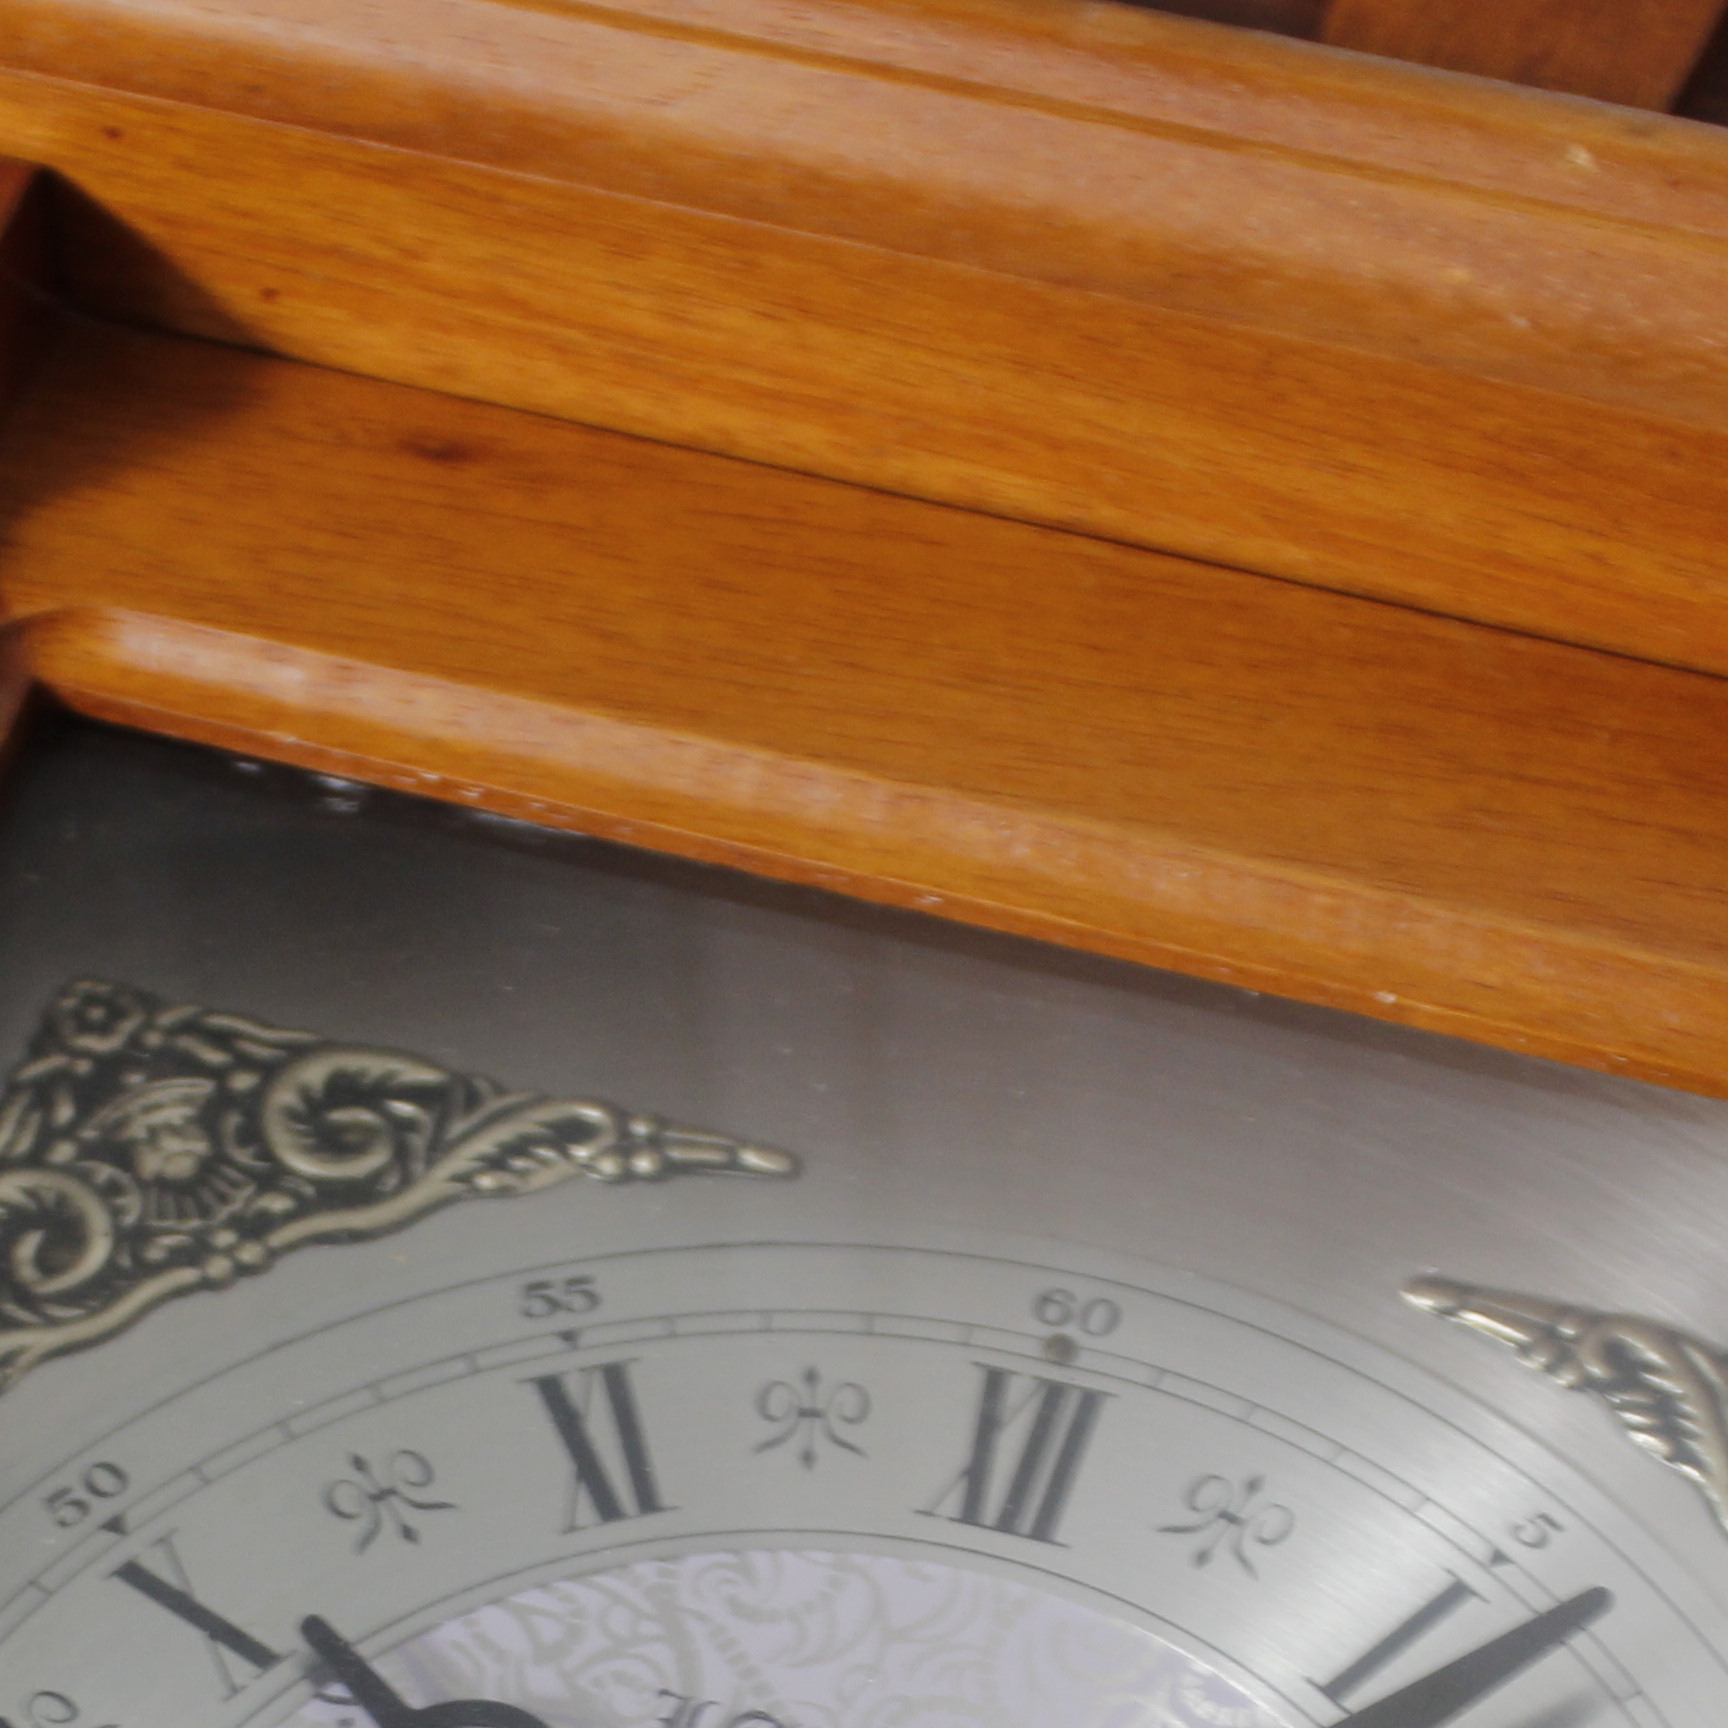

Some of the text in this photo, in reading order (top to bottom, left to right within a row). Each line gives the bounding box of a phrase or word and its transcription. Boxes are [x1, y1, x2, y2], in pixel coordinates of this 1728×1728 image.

[519, 1275, 601, 1319] 55
[1030, 1287, 1122, 1337] 60
[516, 1357, 678, 1534] XI
[913, 1361, 1119, 1548] XII
[45, 1461, 129, 1528] 50
[1507, 1510, 1566, 1552] 5
[104, 1528, 298, 1703] X
